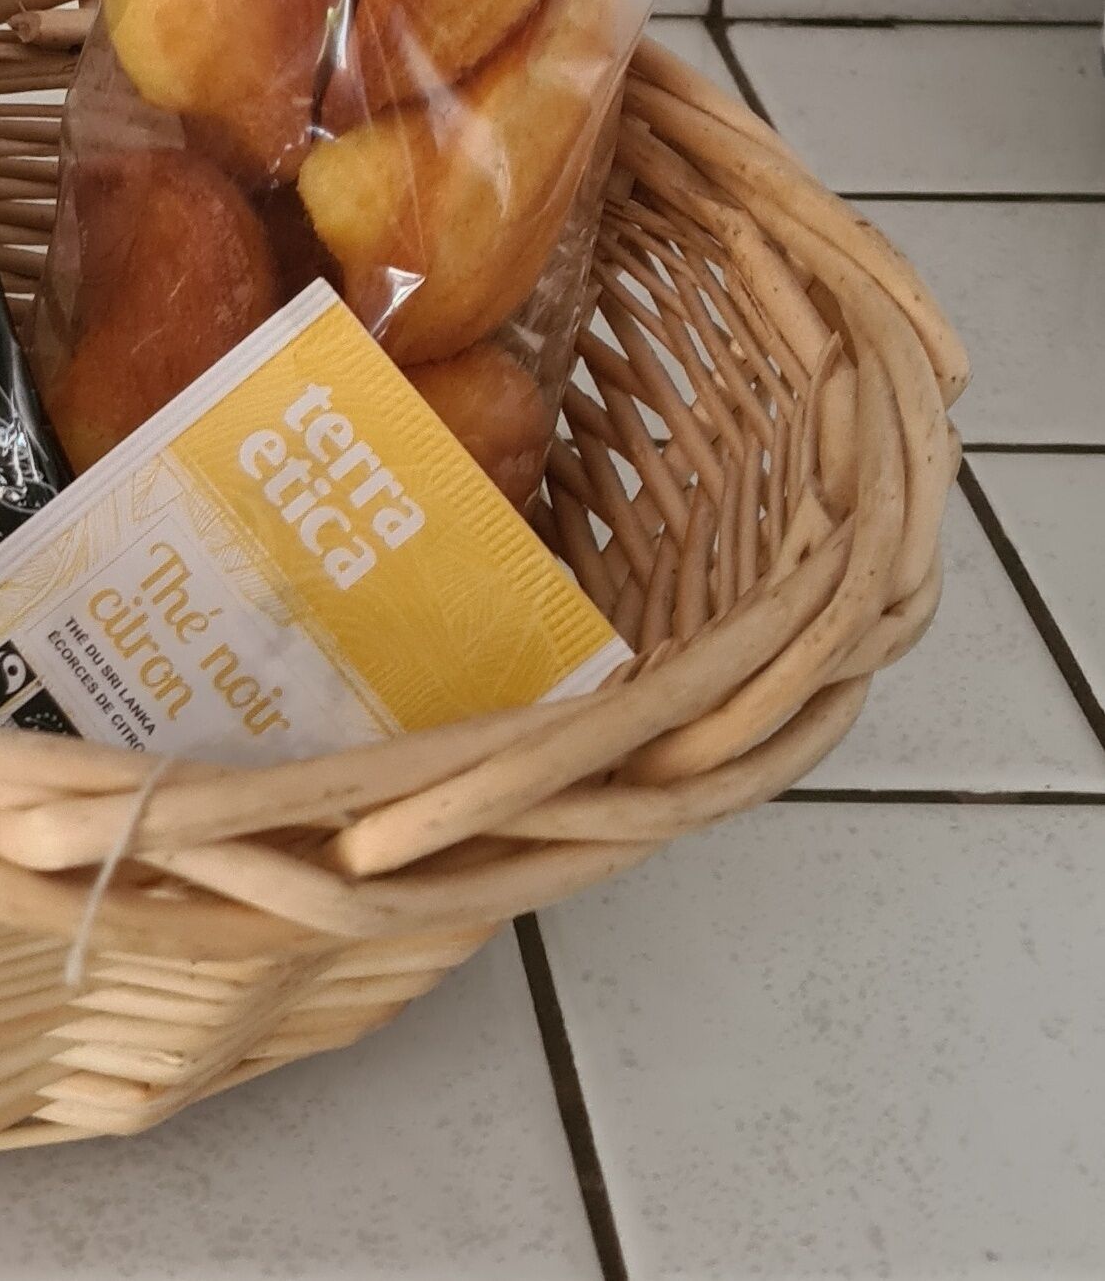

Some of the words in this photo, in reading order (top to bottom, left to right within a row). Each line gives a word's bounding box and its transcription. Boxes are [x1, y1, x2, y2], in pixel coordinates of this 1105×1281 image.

[238, 429, 377, 590] etica
[284, 383, 426, 550] terra
[47, 629, 98, 693] ÉCORCES
[95, 692, 115, 714] DE
[111, 713, 146, 752] CITRO
[64, 615, 90, 646] THÉ
[84, 641, 104, 666] DU
[101, 664, 122, 690] SRI
[118, 684, 156, 736] LANKA
[88, 588, 193, 720] citron
[140, 541, 222, 645] Thé
[200, 643, 291, 735] noir
